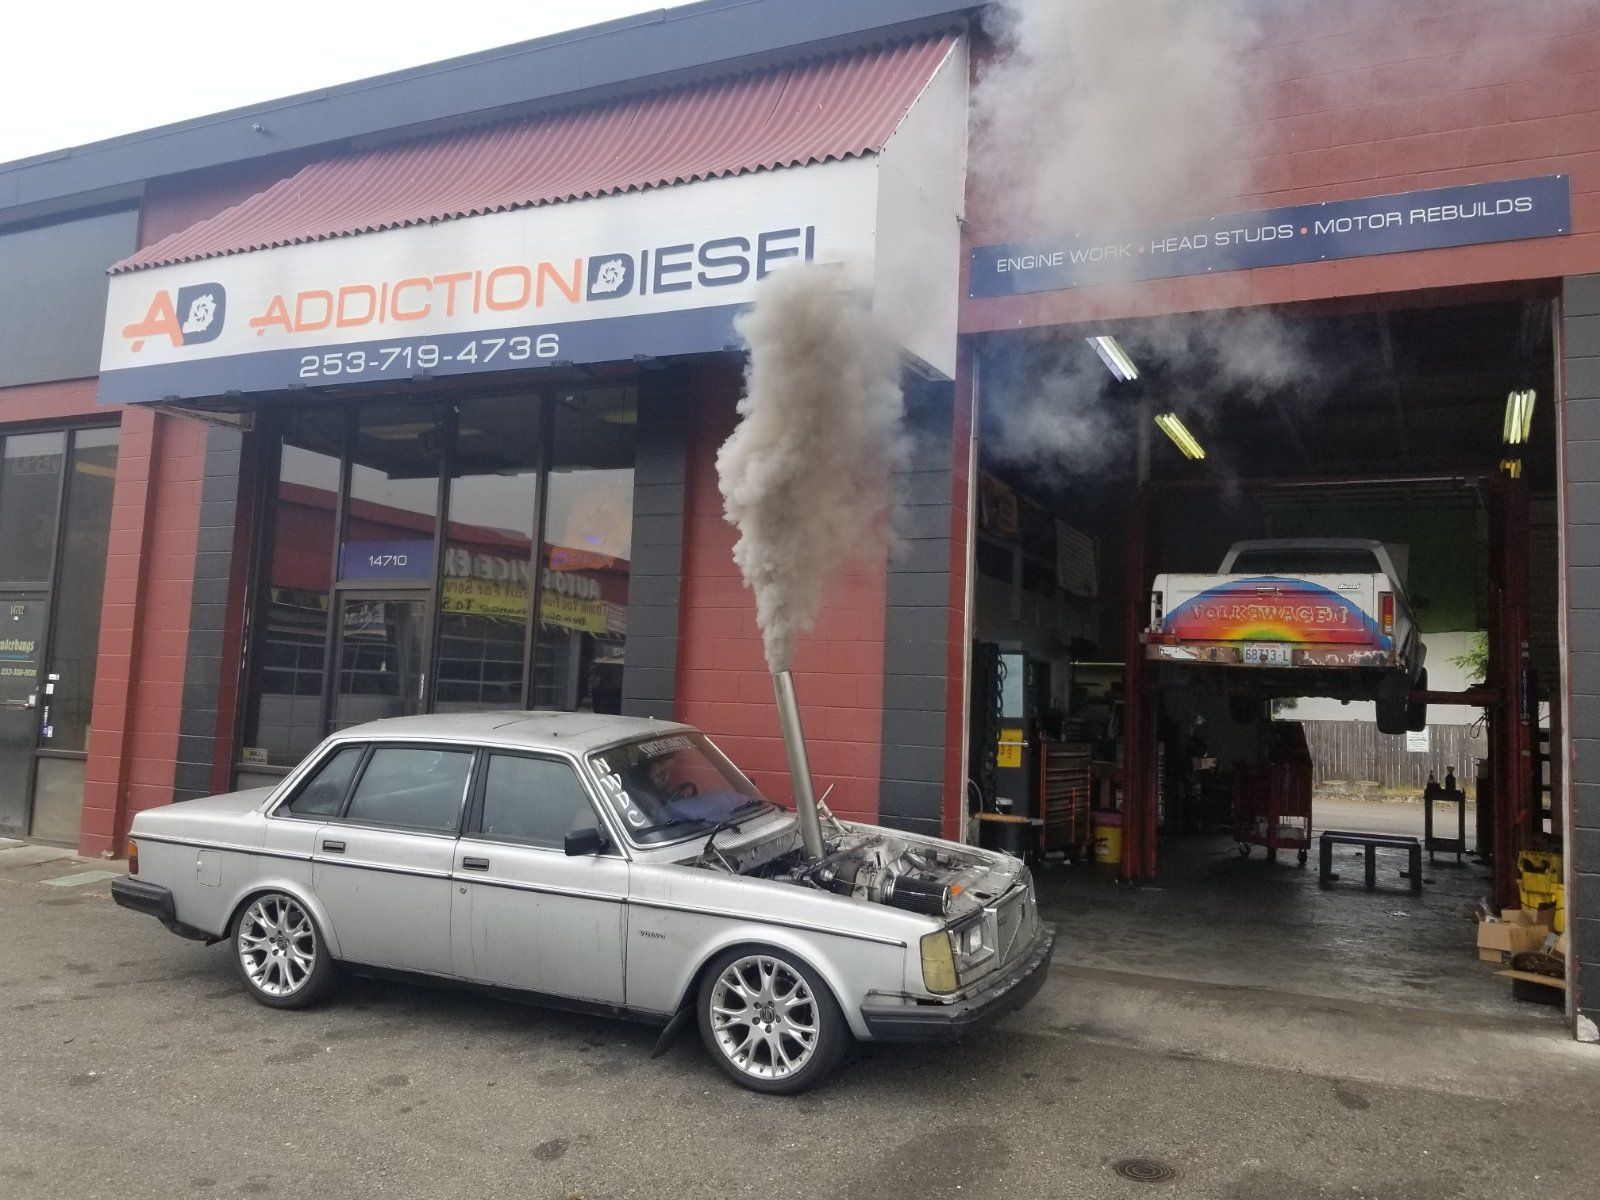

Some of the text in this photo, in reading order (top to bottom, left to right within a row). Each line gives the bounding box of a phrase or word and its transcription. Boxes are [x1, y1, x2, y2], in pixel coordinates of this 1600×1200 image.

[1314, 196, 1533, 236] MOTOR REBUILDS
[1151, 225, 1294, 255] HEAD STUDS
[996, 243, 1133, 273] ENGINE WORK
[299, 333, 560, 378] 253-719-4736
[368, 554, 408, 567] 14710
[1190, 604, 1348, 625] VOLKSWAGEN
